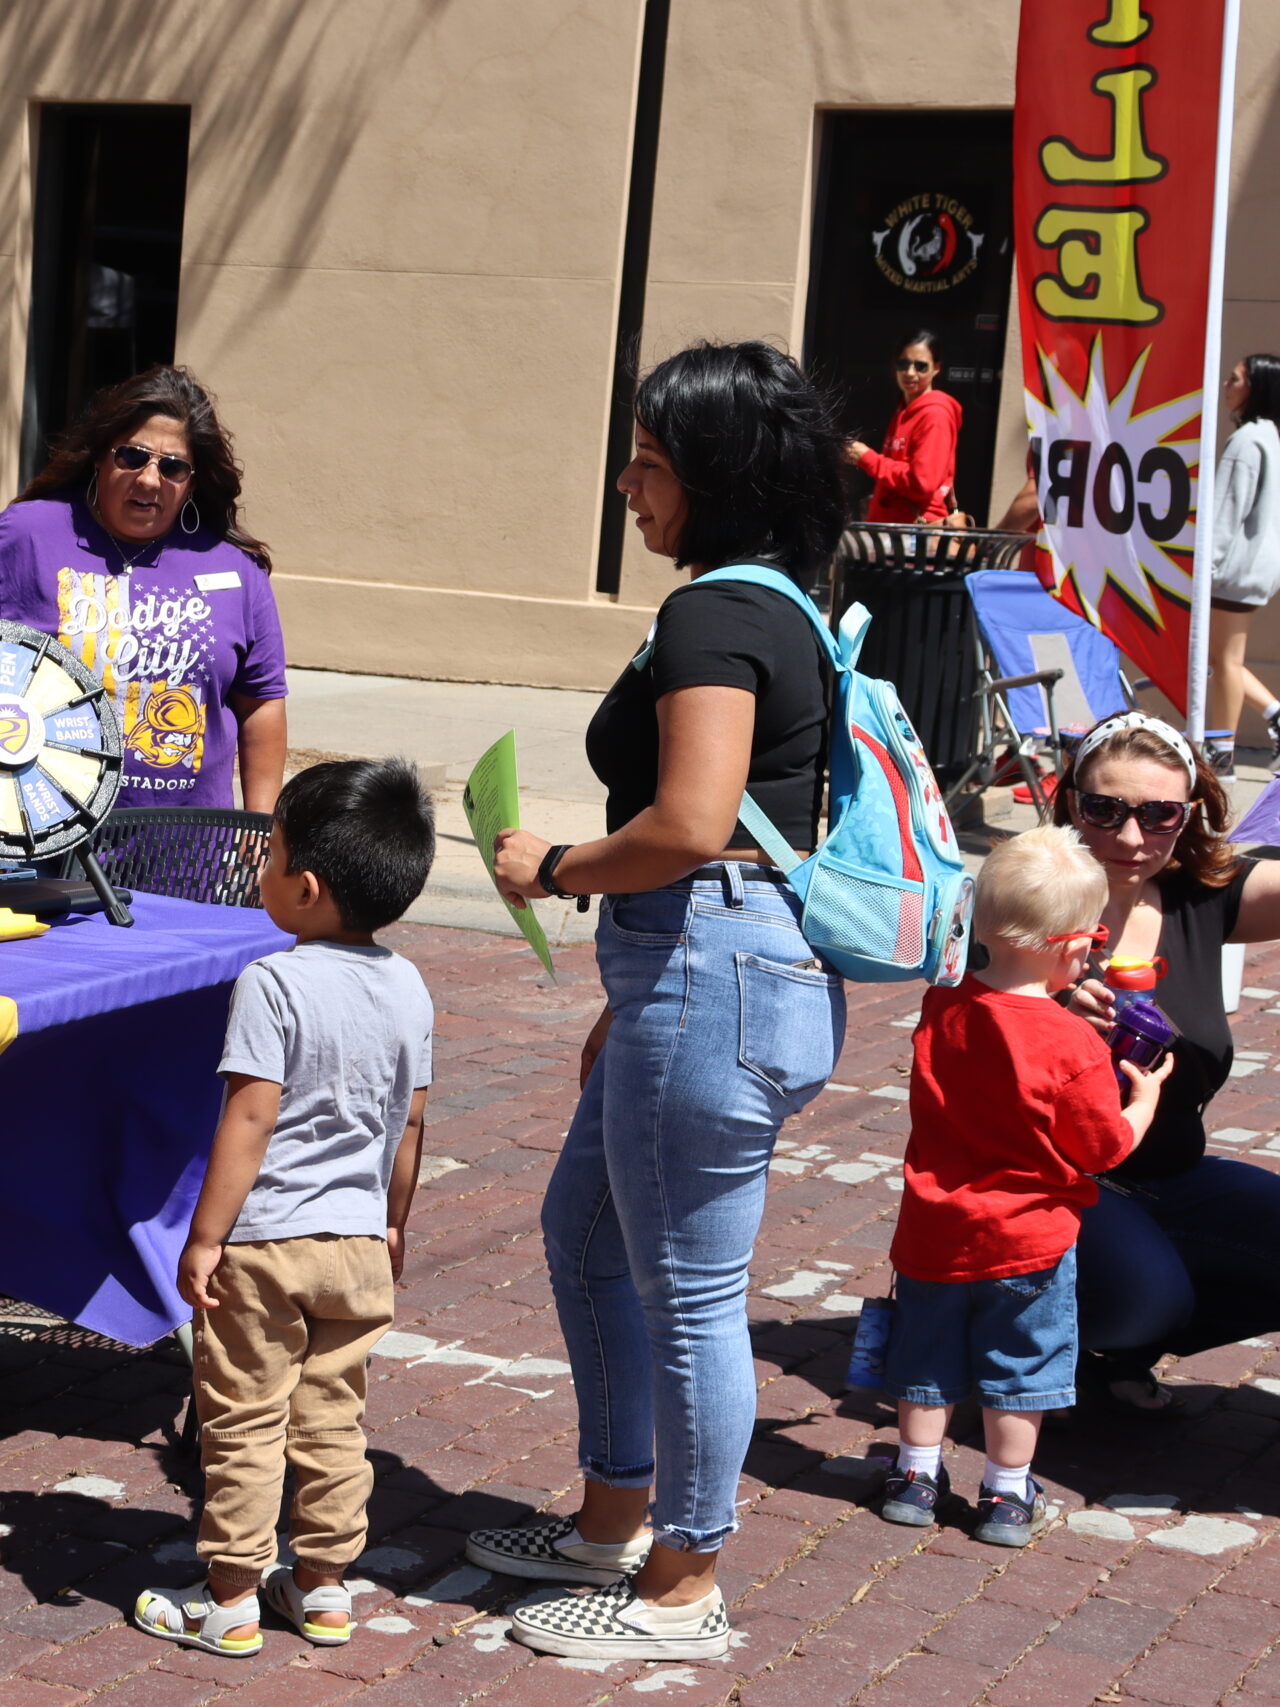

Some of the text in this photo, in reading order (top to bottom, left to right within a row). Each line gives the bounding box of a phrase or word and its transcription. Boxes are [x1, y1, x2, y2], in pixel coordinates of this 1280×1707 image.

[884, 192, 974, 230] WHITE TIGER
[62, 594, 211, 636] Dodge
[0, 650, 18, 687] PEN
[100, 633, 200, 686] City
[53, 716, 91, 730] WRIST
[55, 728, 95, 741] BANDS
[23, 783, 50, 822] BANDS
[35, 778, 61, 816] WRIST
